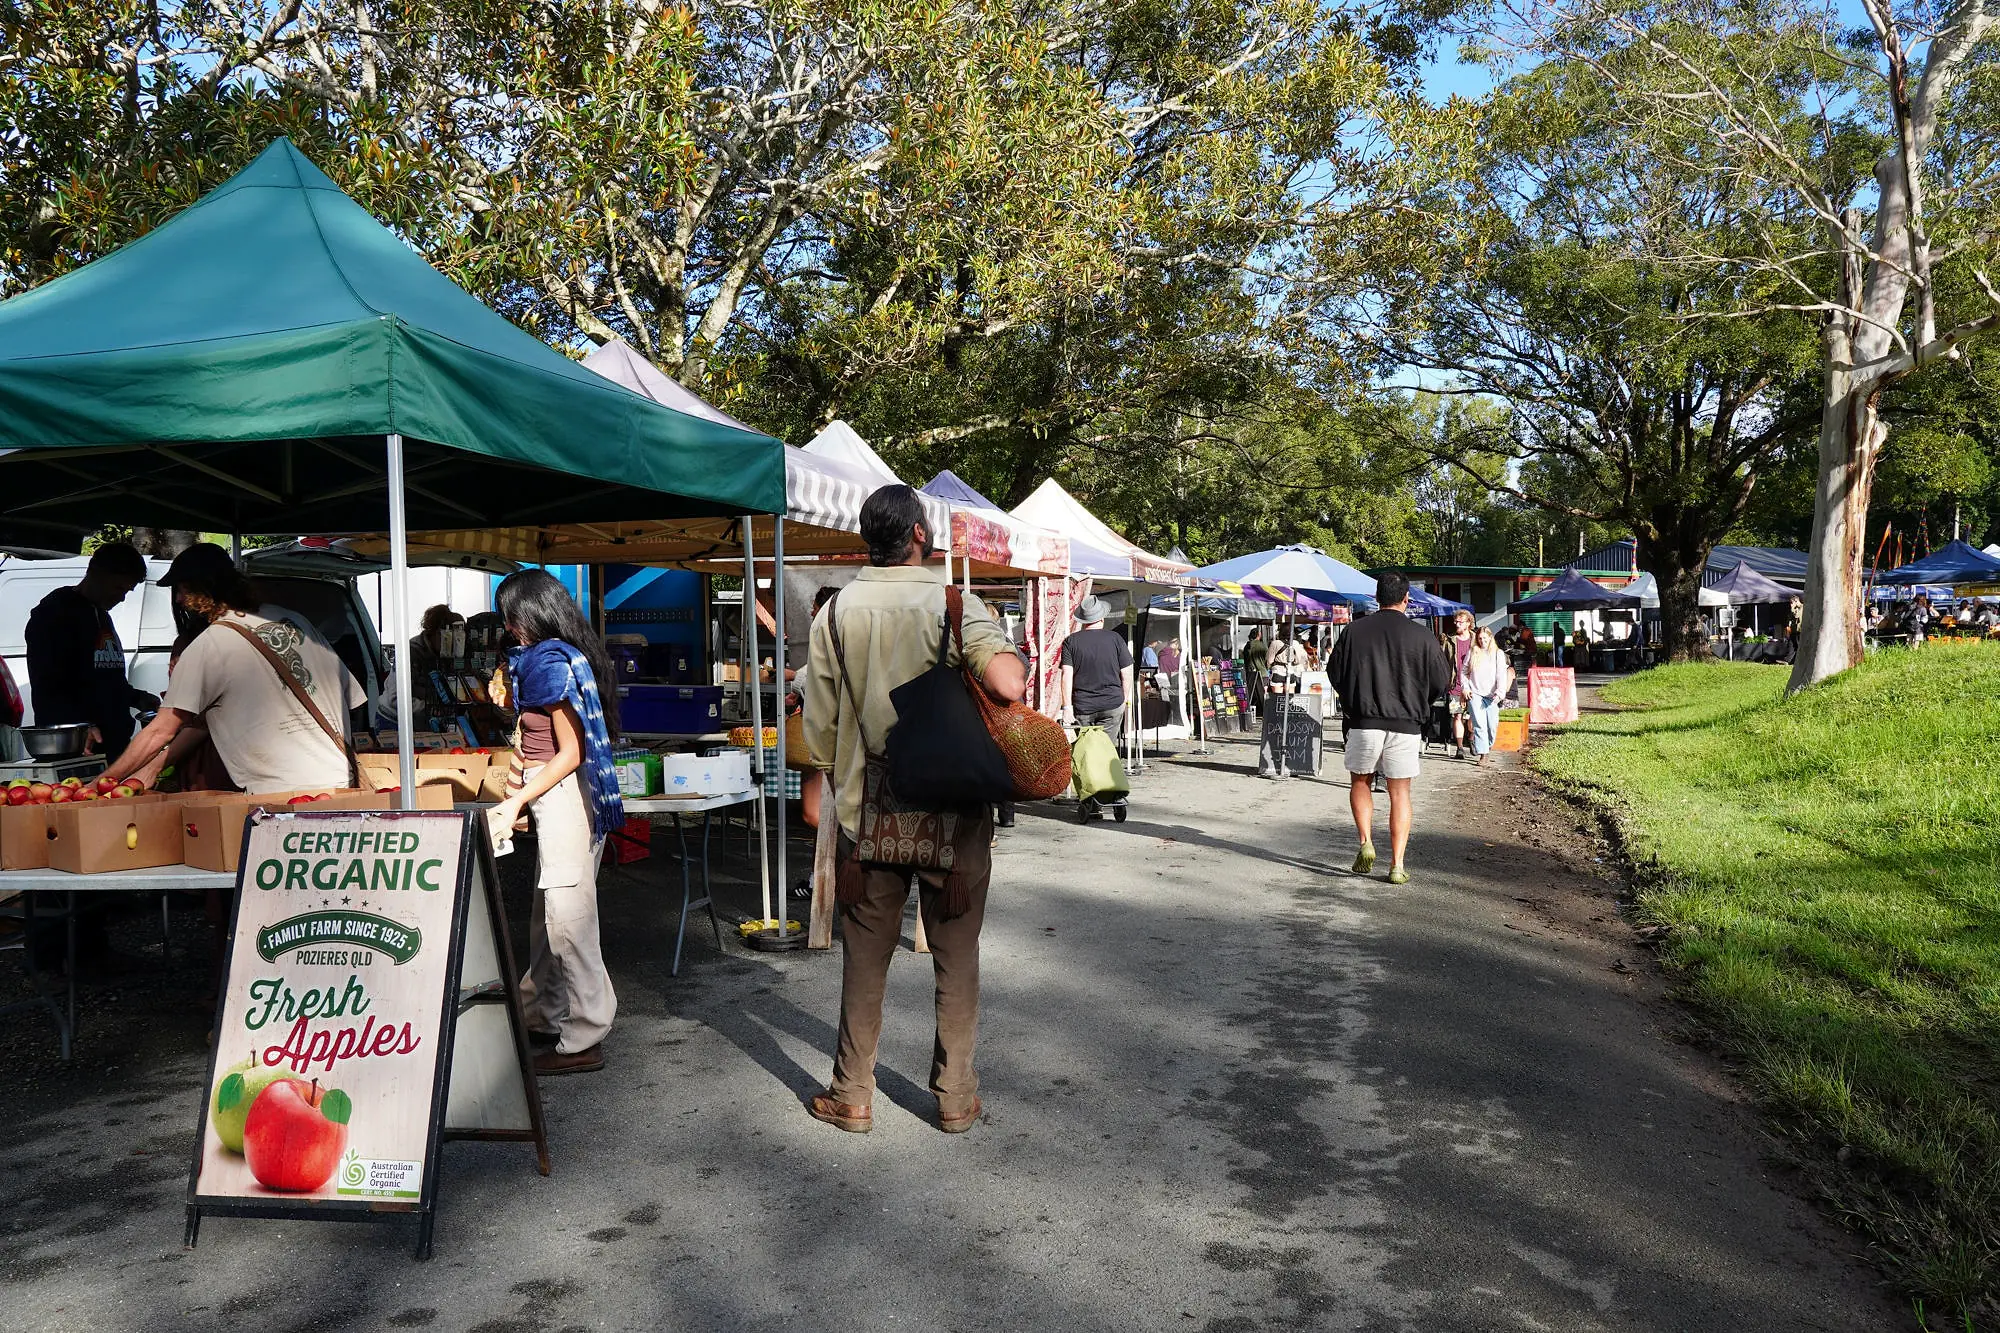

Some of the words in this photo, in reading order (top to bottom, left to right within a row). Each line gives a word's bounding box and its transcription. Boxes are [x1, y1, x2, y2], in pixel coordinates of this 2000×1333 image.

[1272, 748, 1306, 764] JAM
[282, 832, 420, 854] CERTIFIED
[255, 858, 443, 892] ORGANIC
[267, 922, 308, 949] FAMILY
[310, 920, 343, 936] FARM
[344, 920, 380, 939] SINCE
[379, 926, 409, 949] 1925
[296, 950, 348, 966] POZIERES
[350, 951, 373, 968] QLD
[245, 974, 371, 1031] Fresh
[262, 1015, 422, 1074] Apples
[370, 1162, 413, 1171] Australian
[370, 1171, 405, 1180] Certified
[369, 1179, 401, 1188] Organic
